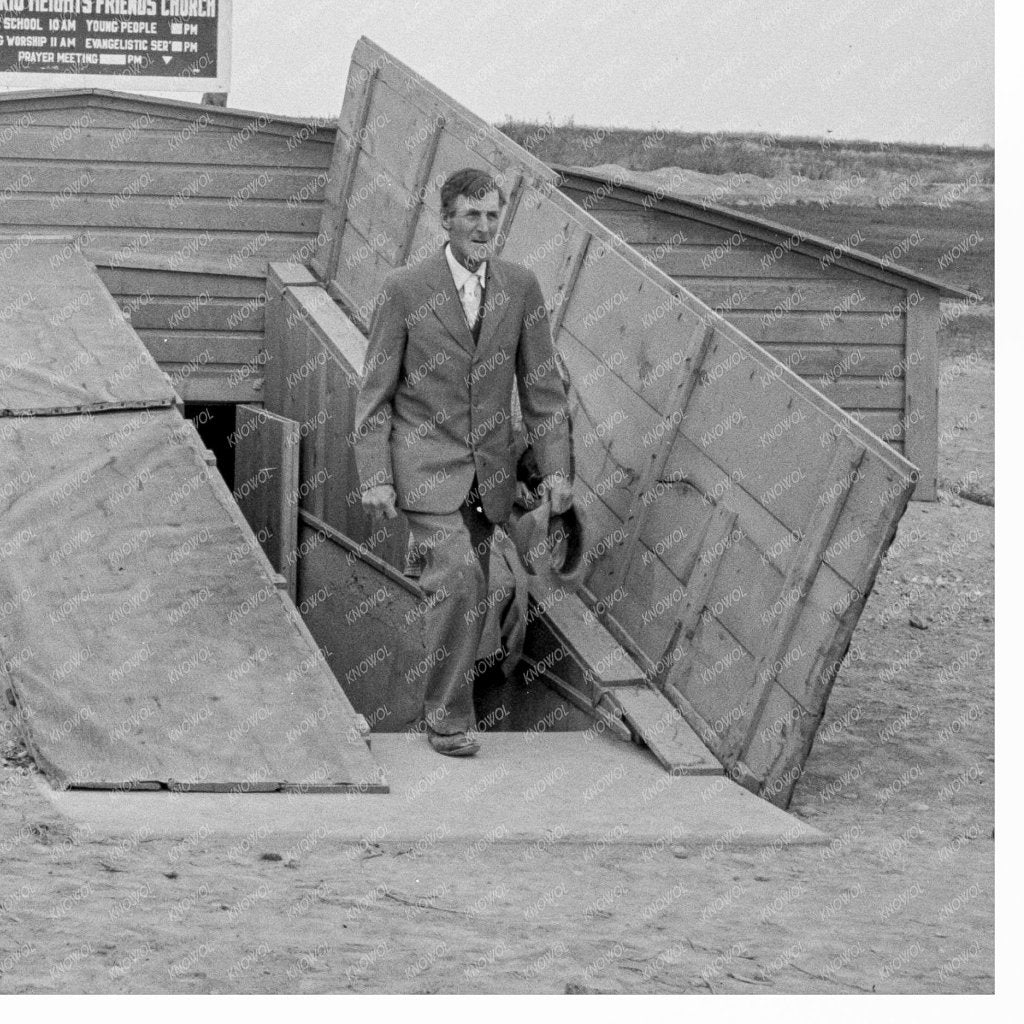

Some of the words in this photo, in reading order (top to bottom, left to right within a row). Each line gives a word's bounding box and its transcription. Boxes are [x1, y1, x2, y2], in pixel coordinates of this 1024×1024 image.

[3, 18, 43, 30] SCHOOL
[49, 19, 59, 30] 10
[61, 19, 76, 31] AM
[86, 20, 119, 32] YOUNG
[121, 22, 157, 34] PEOPLE
[184, 24, 198, 35] PM
[6, 36, 47, 47] WORSHIP
[50, 37, 57, 47] 11
[60, 38, 76, 47] AM
[85, 38, 148, 50] EVANGELISTIC
[184, 42, 198, 52] PM
[18, 51, 54, 62] PRAYER
[57, 52, 98, 64] MEETING
[128, 55, 142, 64] PM
